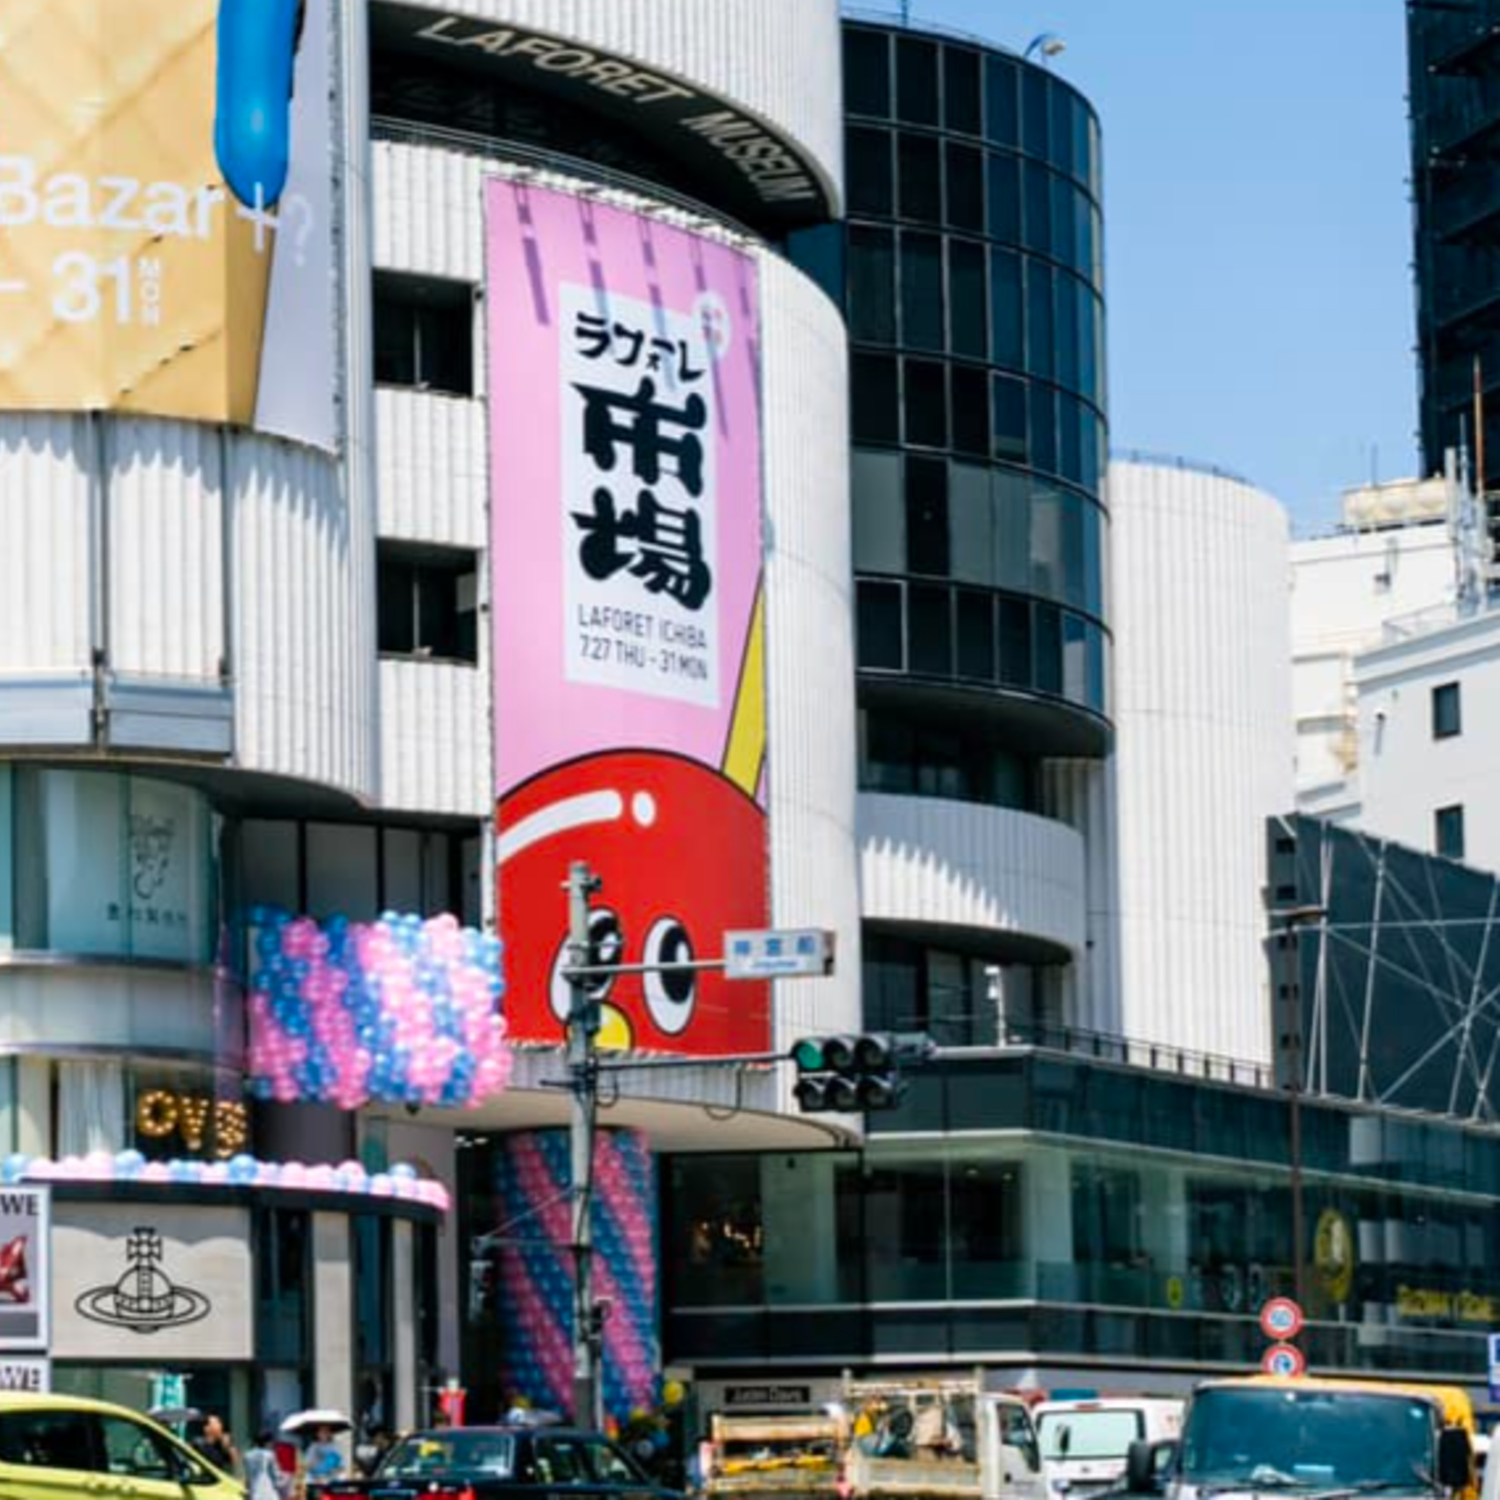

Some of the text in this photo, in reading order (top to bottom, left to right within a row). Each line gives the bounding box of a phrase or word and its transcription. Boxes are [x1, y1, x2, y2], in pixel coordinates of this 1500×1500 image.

[417, 15, 818, 204] LAFORET MUSEUM
[51, 251, 131, 325] 31
[568, 375, 712, 611] 市場
[578, 602, 654, 645] LAFORET
